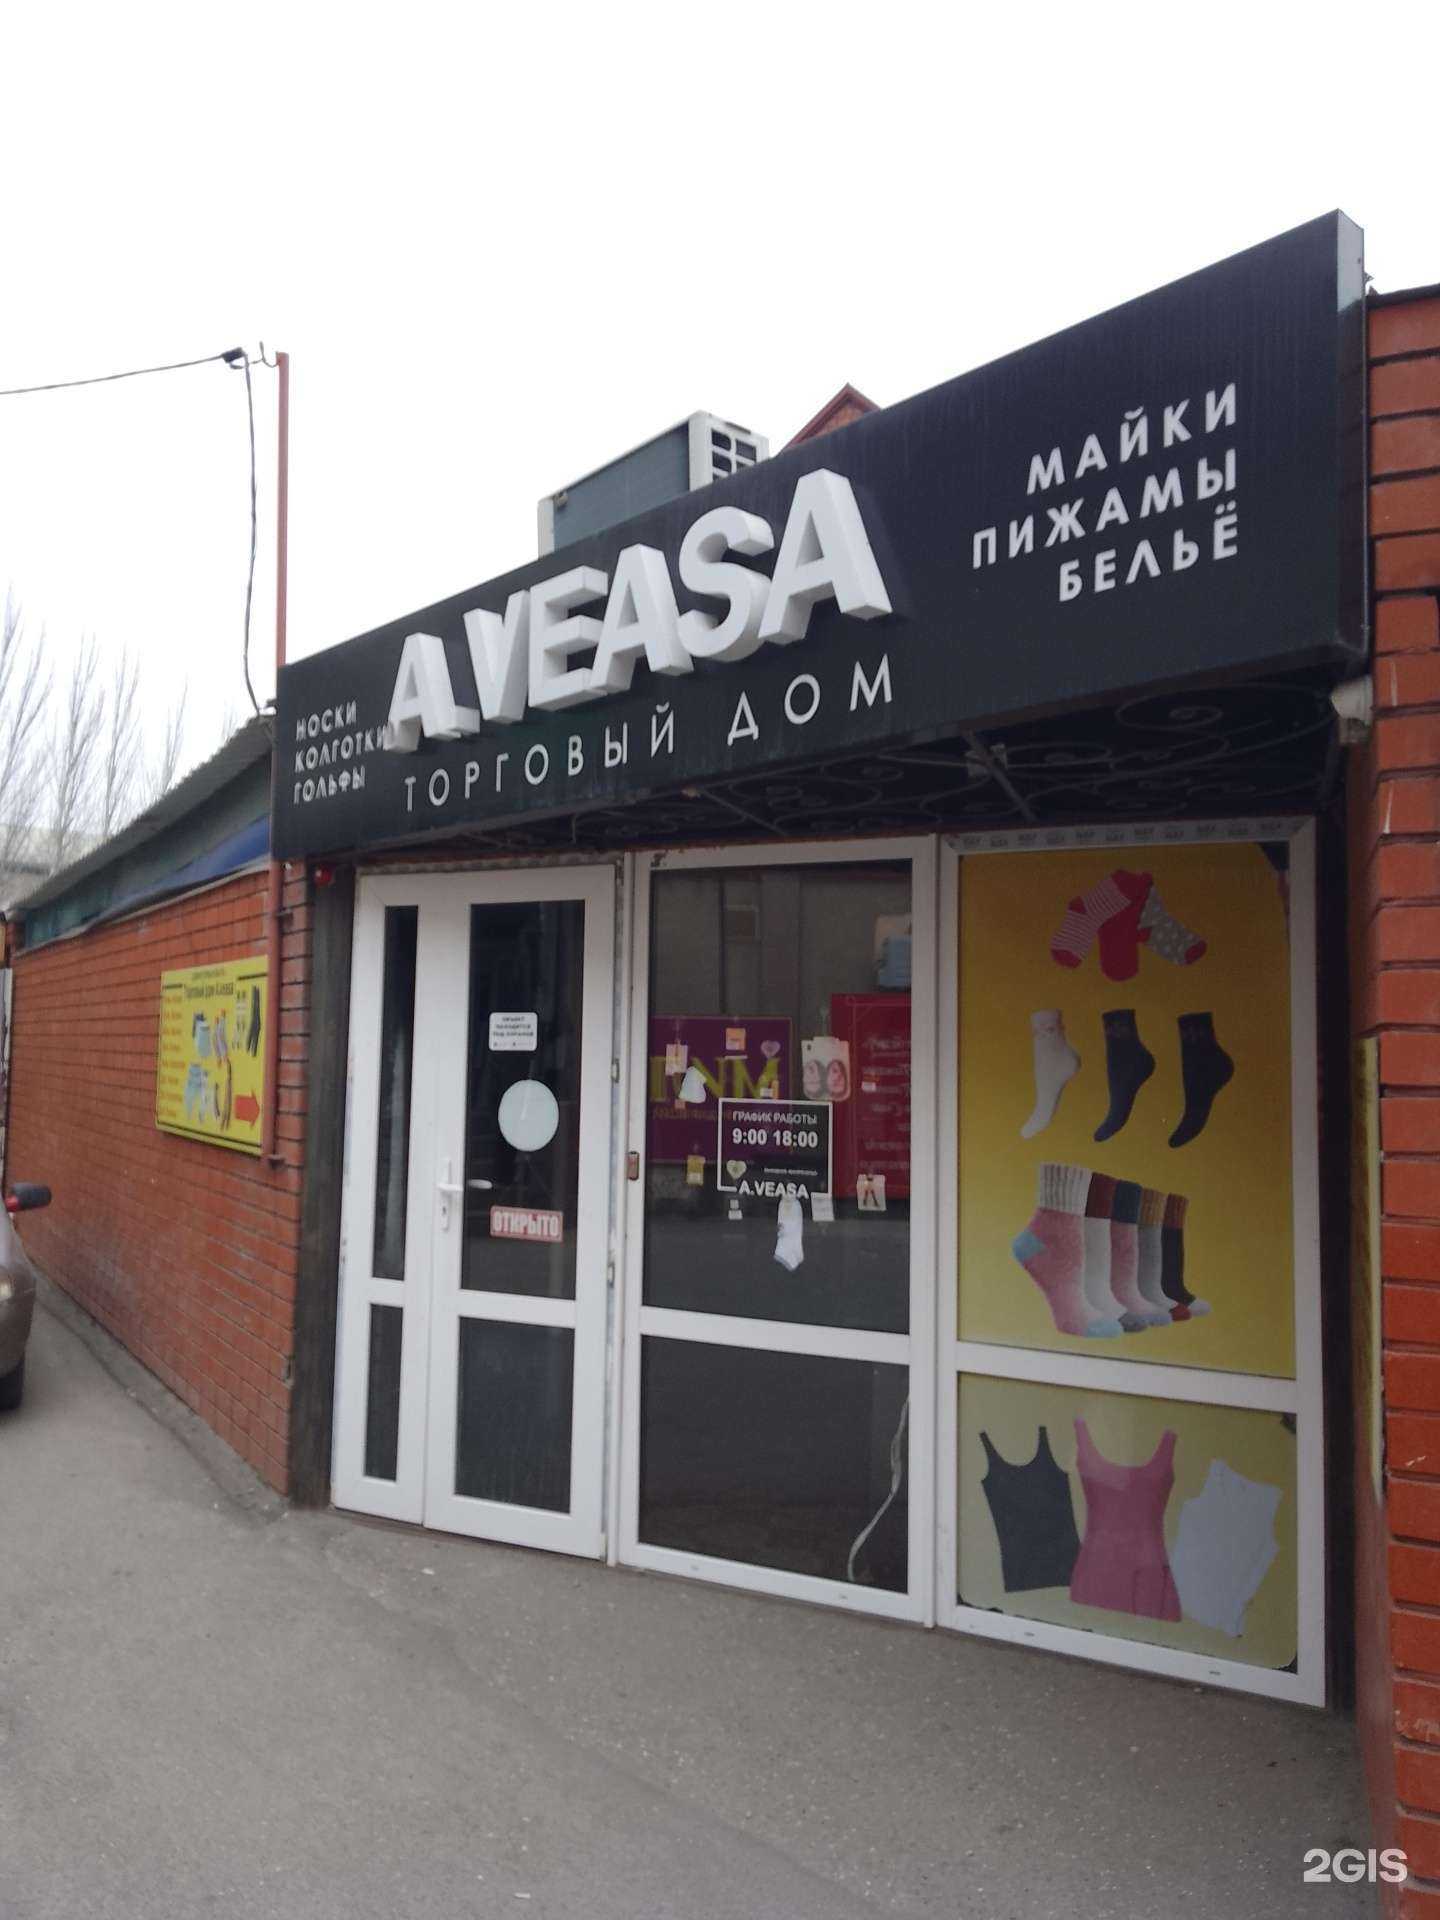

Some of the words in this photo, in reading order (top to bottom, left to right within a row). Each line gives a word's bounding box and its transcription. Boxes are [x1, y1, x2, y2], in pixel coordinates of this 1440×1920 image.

[1027, 382, 1236, 495] МАЙКИ
[973, 449, 1236, 569] ПИЖАМЫ
[1059, 500, 1238, 602] БЕЛЬЁ
[296, 700, 357, 741] НОСКИ
[404, 703, 674, 811] ТОРГОВЫЙ
[727, 653, 892, 746] ДОМ
[294, 765, 366, 805] ГОЛЬФЫ
[732, 1110, 771, 1123] ГРАФИК
[773, 1112, 817, 1125] РАБОТЫ
[732, 1128, 768, 1146] 9:00
[773, 1130, 818, 1148] 18:00
[739, 1180, 809, 1199] A.VEASA
